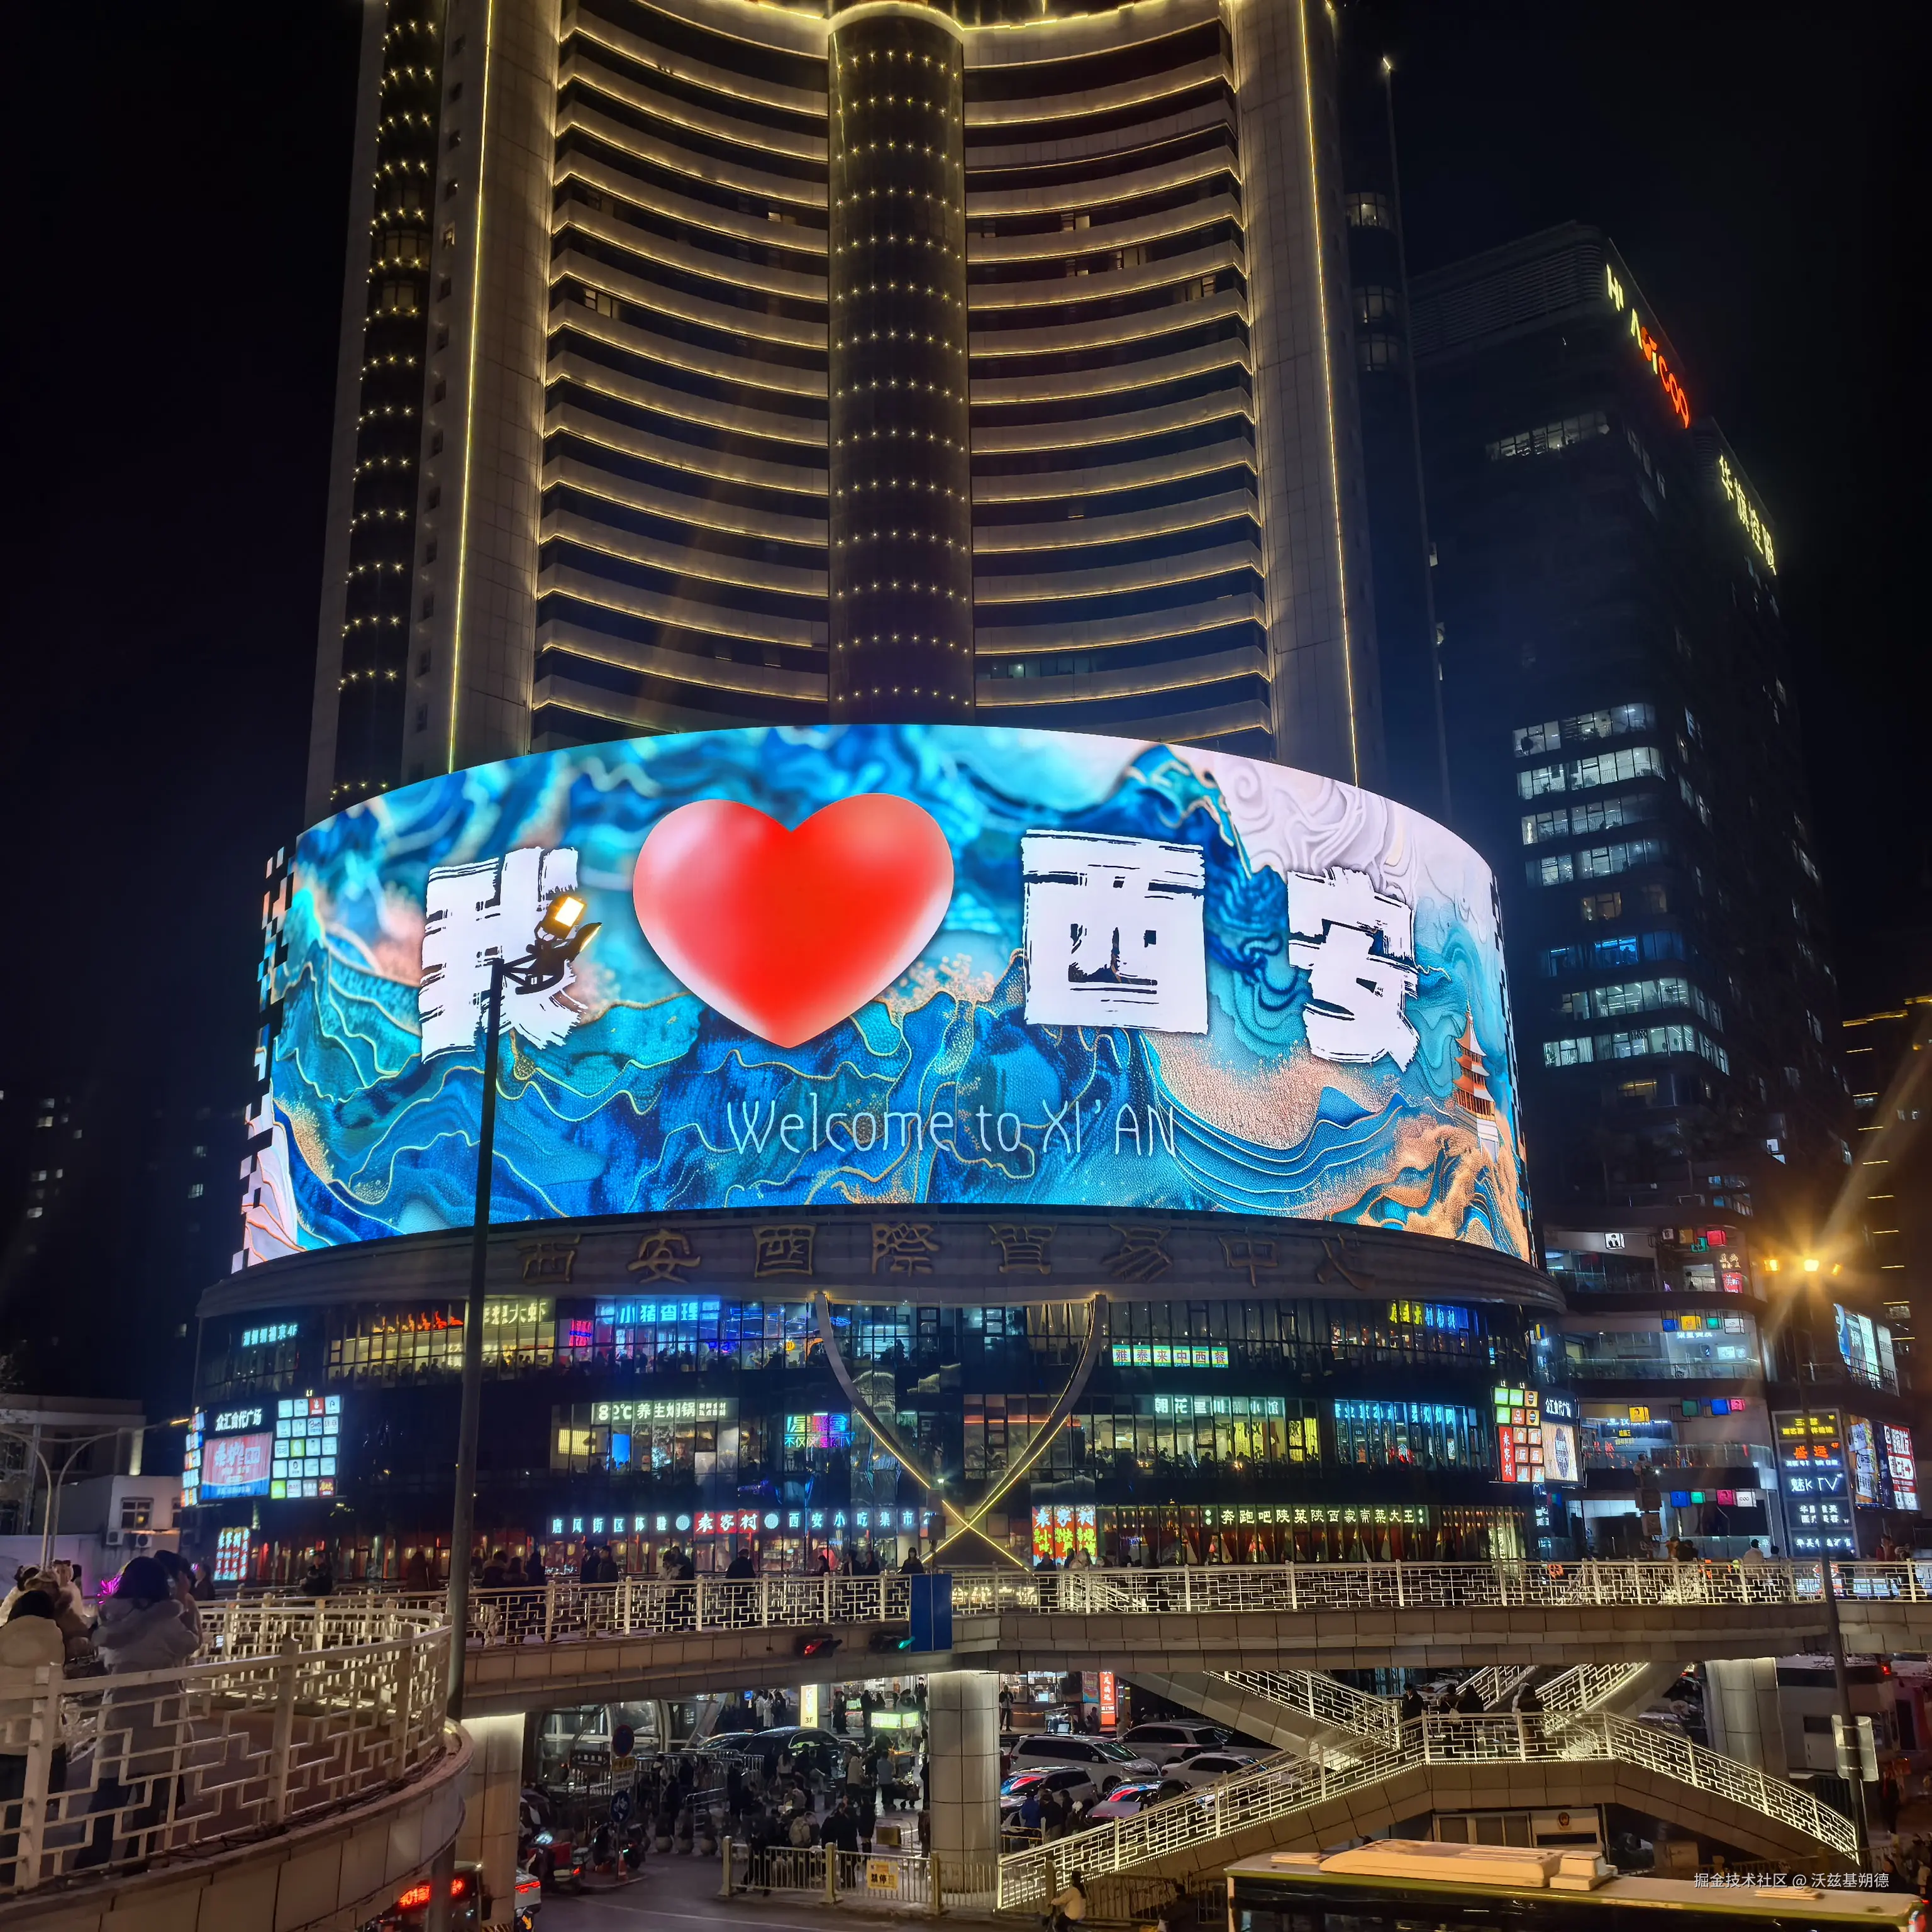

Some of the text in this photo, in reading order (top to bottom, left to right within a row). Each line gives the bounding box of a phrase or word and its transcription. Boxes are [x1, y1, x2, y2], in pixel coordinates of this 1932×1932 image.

[419, 828, 1420, 1068] 我 西安
[726, 1092, 955, 1155] Welcome
[975, 1104, 1021, 1153] to
[620, 1302, 697, 1323] 小猪查理
[1116, 1349, 1226, 1364] 雅泰来中西餐
[789, 1511, 913, 1528] 西安小吃集市
